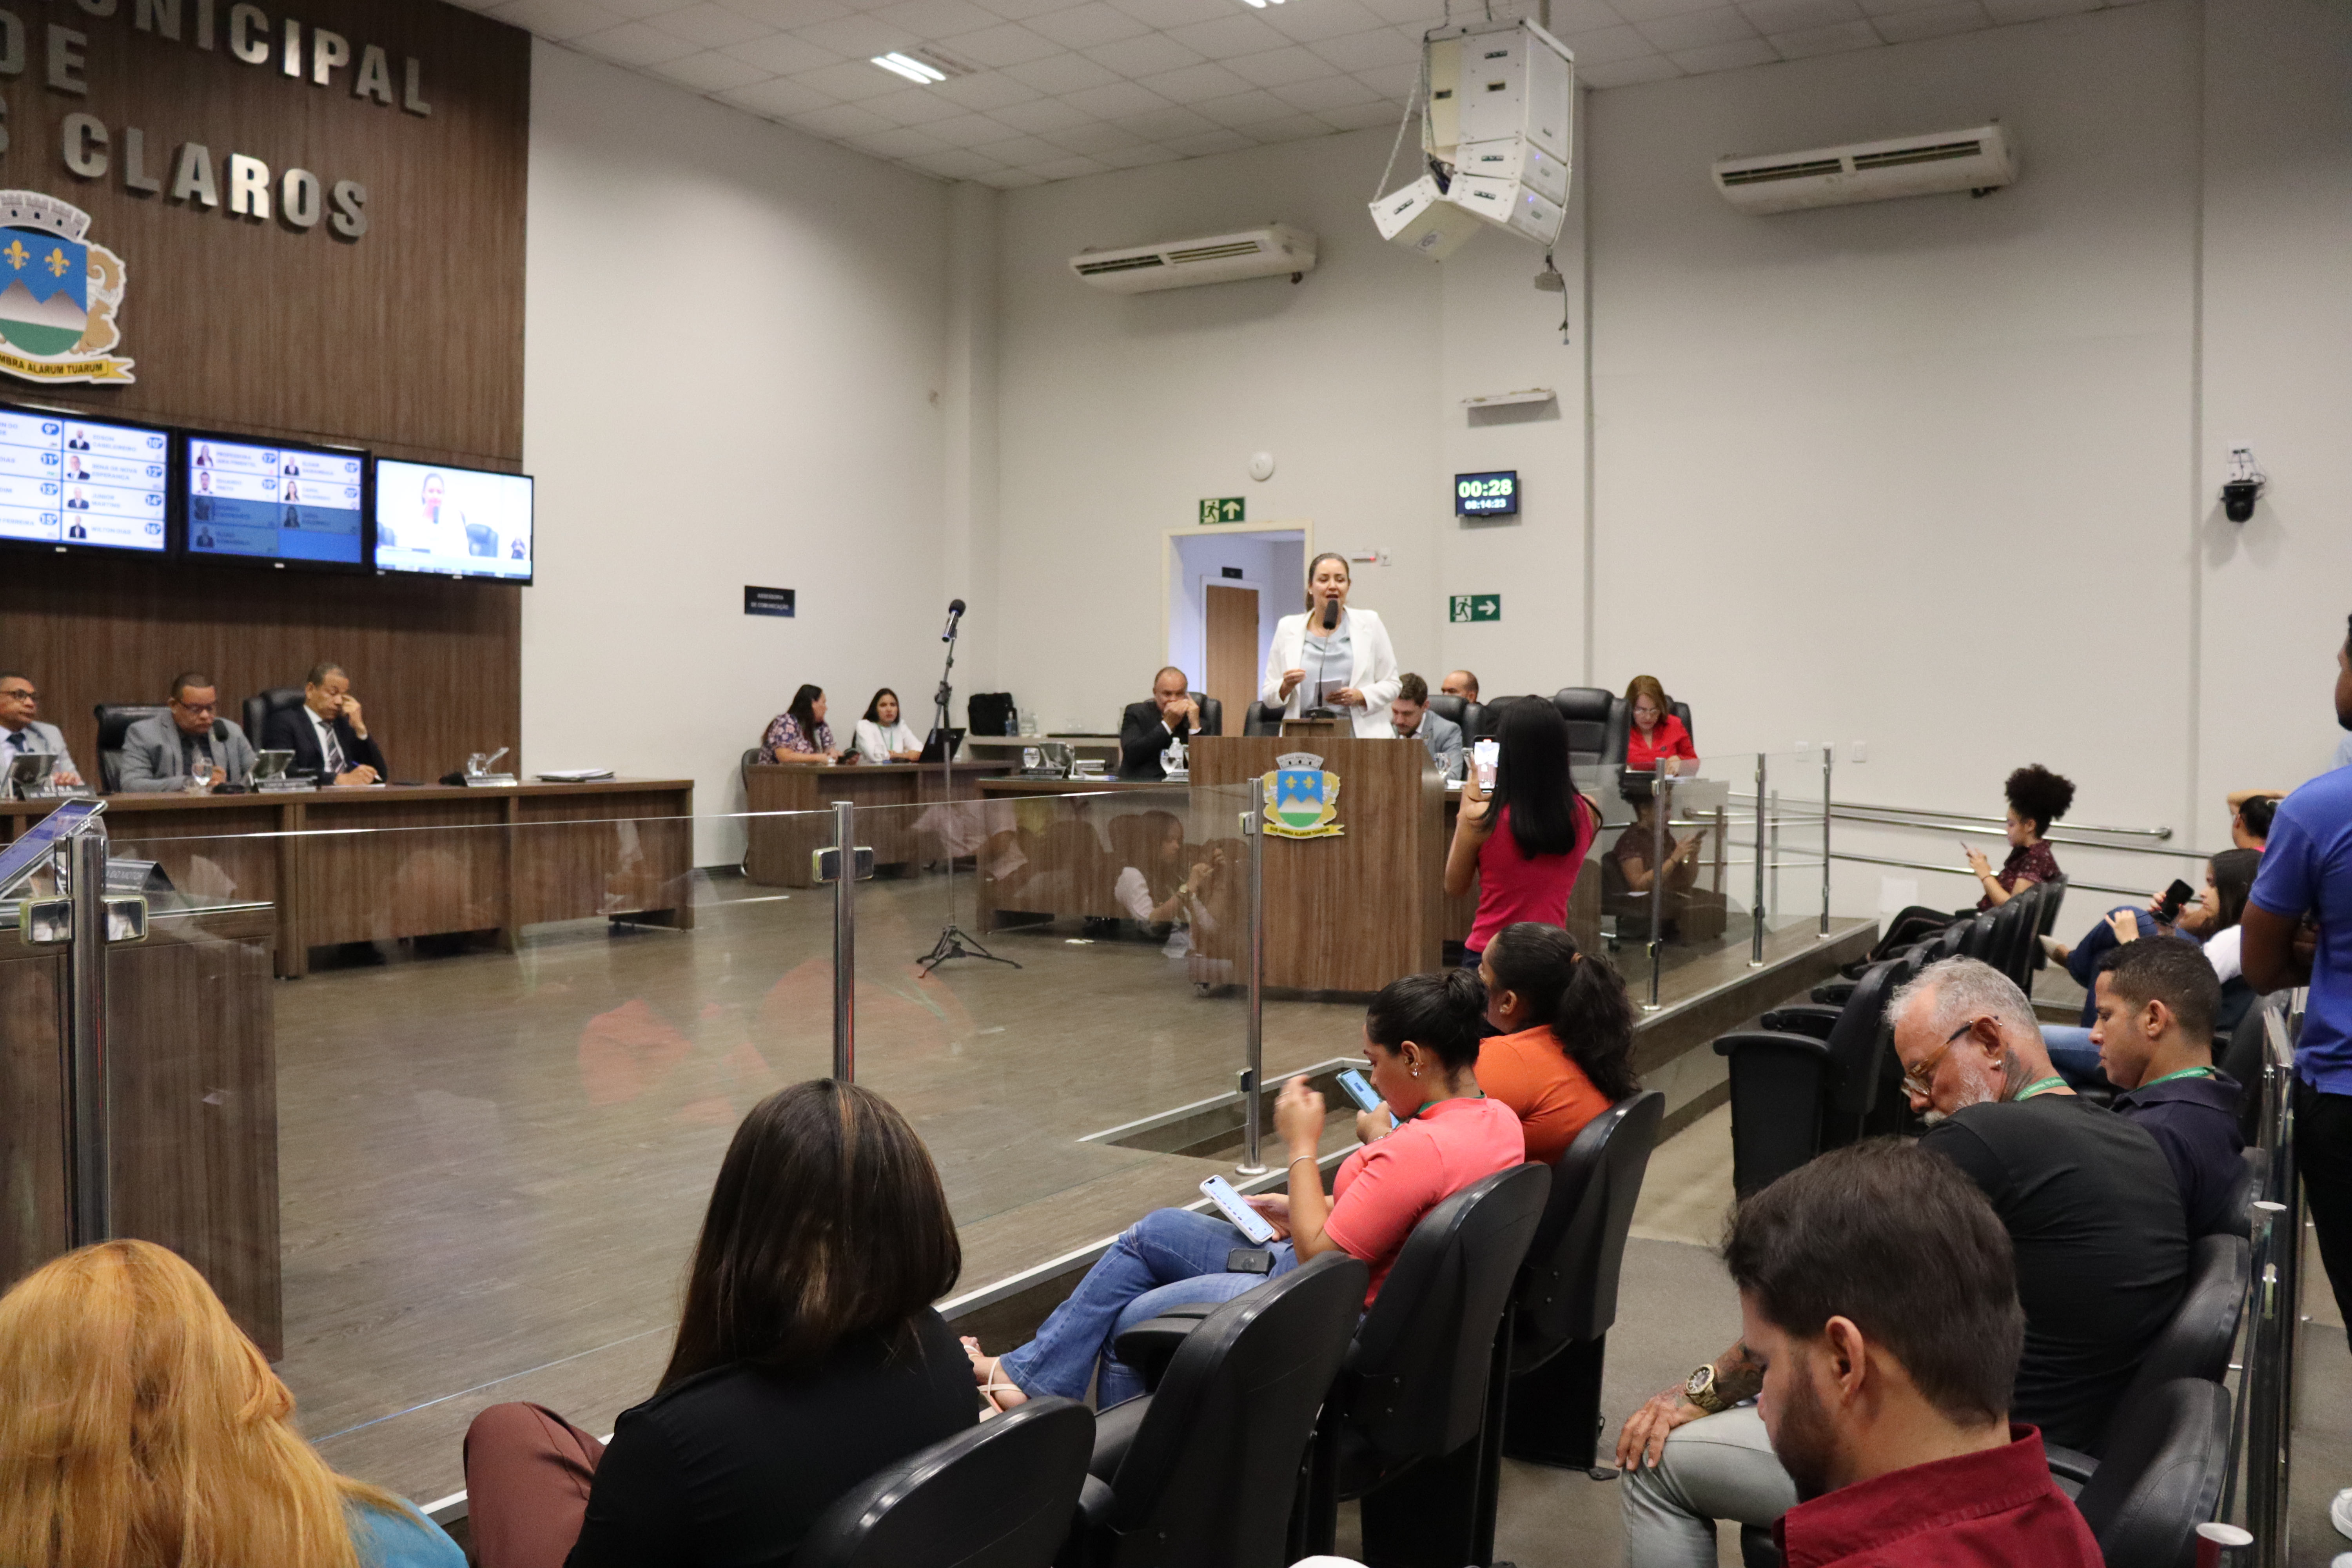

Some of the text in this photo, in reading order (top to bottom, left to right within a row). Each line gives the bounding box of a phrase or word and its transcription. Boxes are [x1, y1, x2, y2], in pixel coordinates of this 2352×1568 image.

[80, 0, 431, 116] NICIPAL
[62, 112, 368, 238] CLAROS
[27, 363, 64, 374] ALARUM
[67, 363, 102, 374] TUARUM
[92, 442, 136, 452] CABELEIREIRO
[1458, 478, 1513, 498] 00:28
[91, 500, 121, 509] MARTINS
[2, 517, 35, 526] FERREIRA
